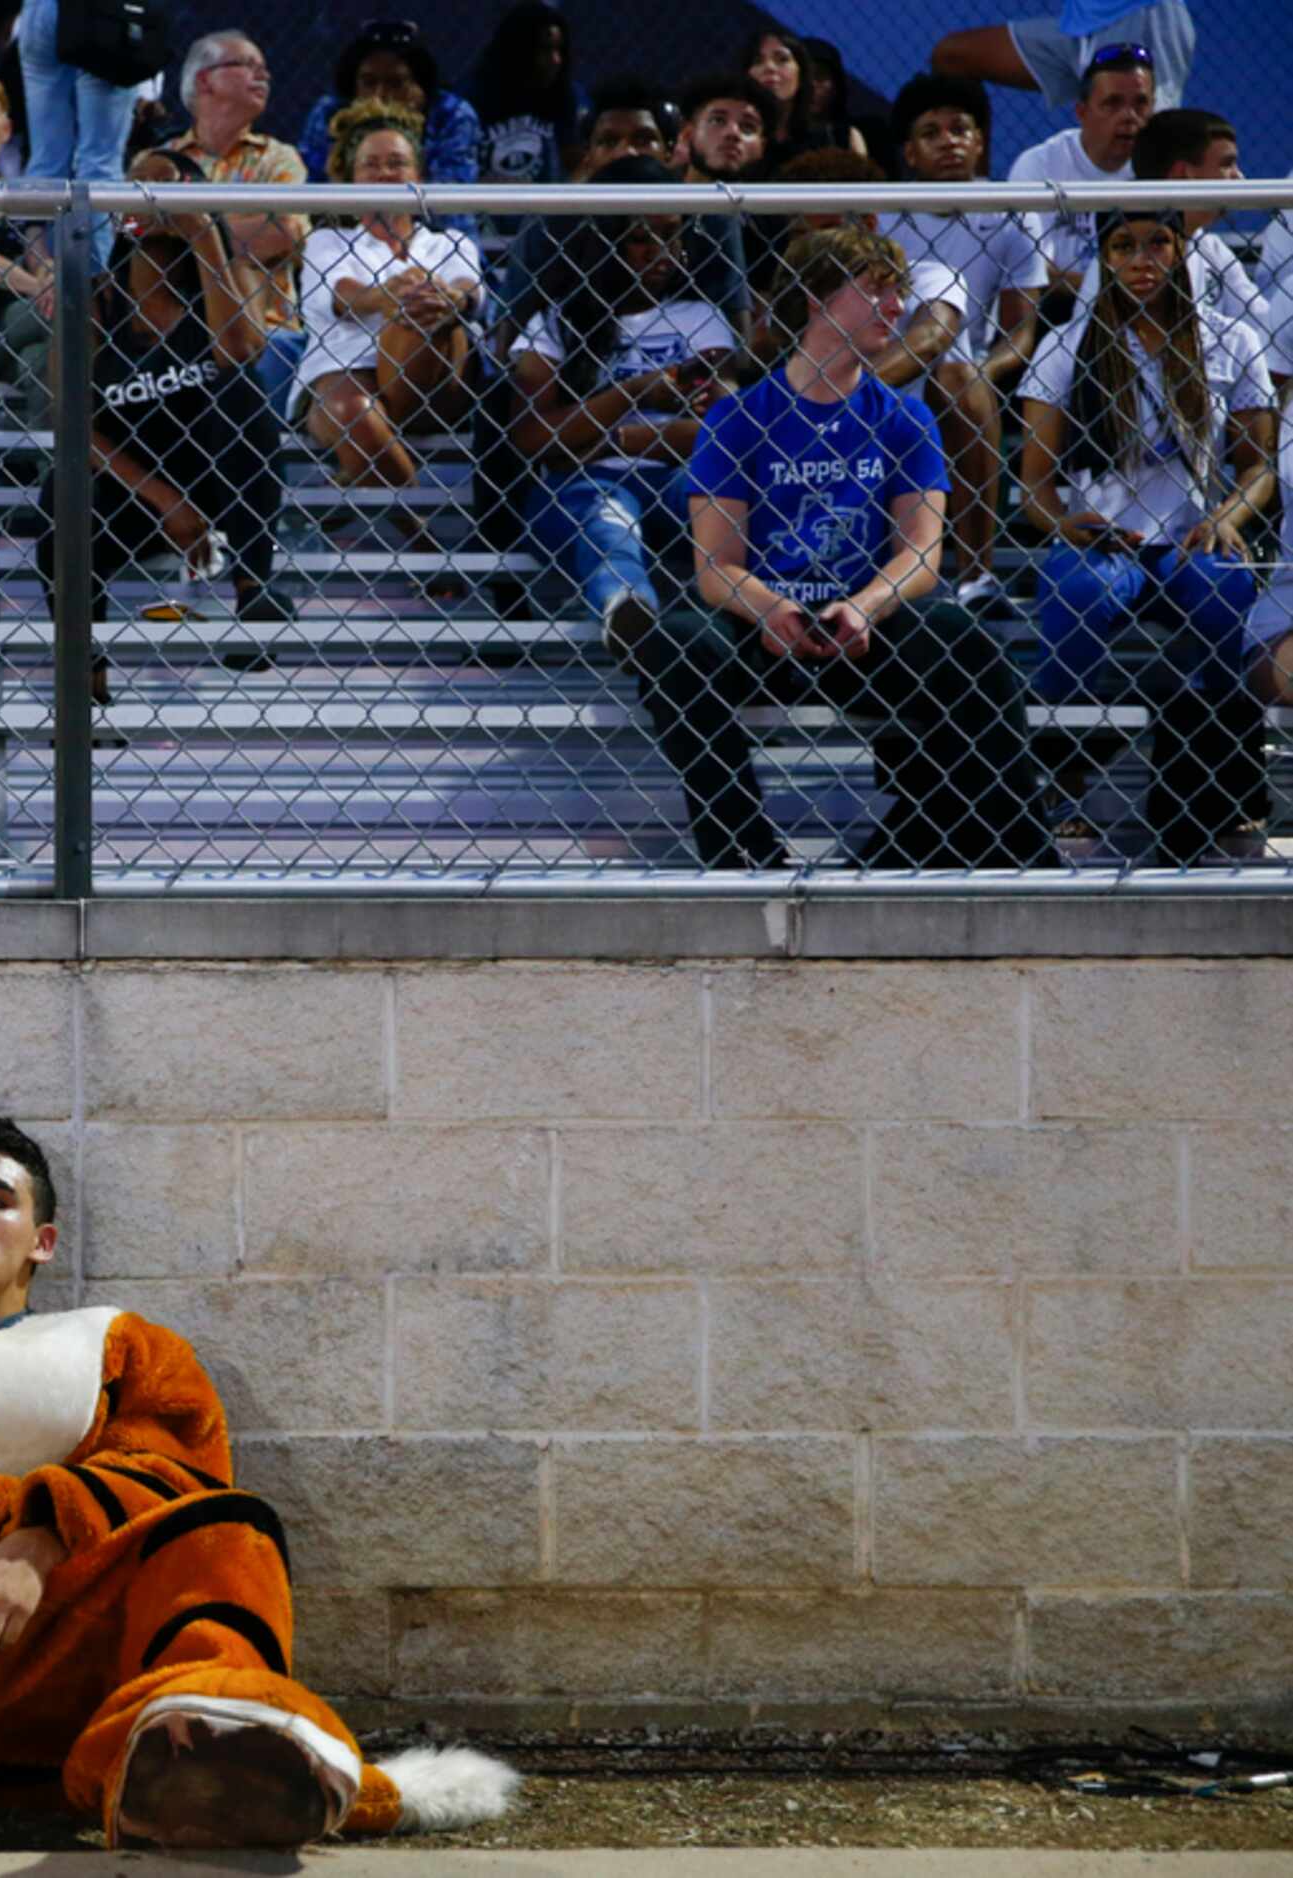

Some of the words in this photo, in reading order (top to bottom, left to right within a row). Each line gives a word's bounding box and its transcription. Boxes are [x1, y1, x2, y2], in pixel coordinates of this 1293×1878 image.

[105, 361, 219, 406] adidas
[770, 461, 846, 485] TAPPS
[858, 457, 885, 480] 5A
